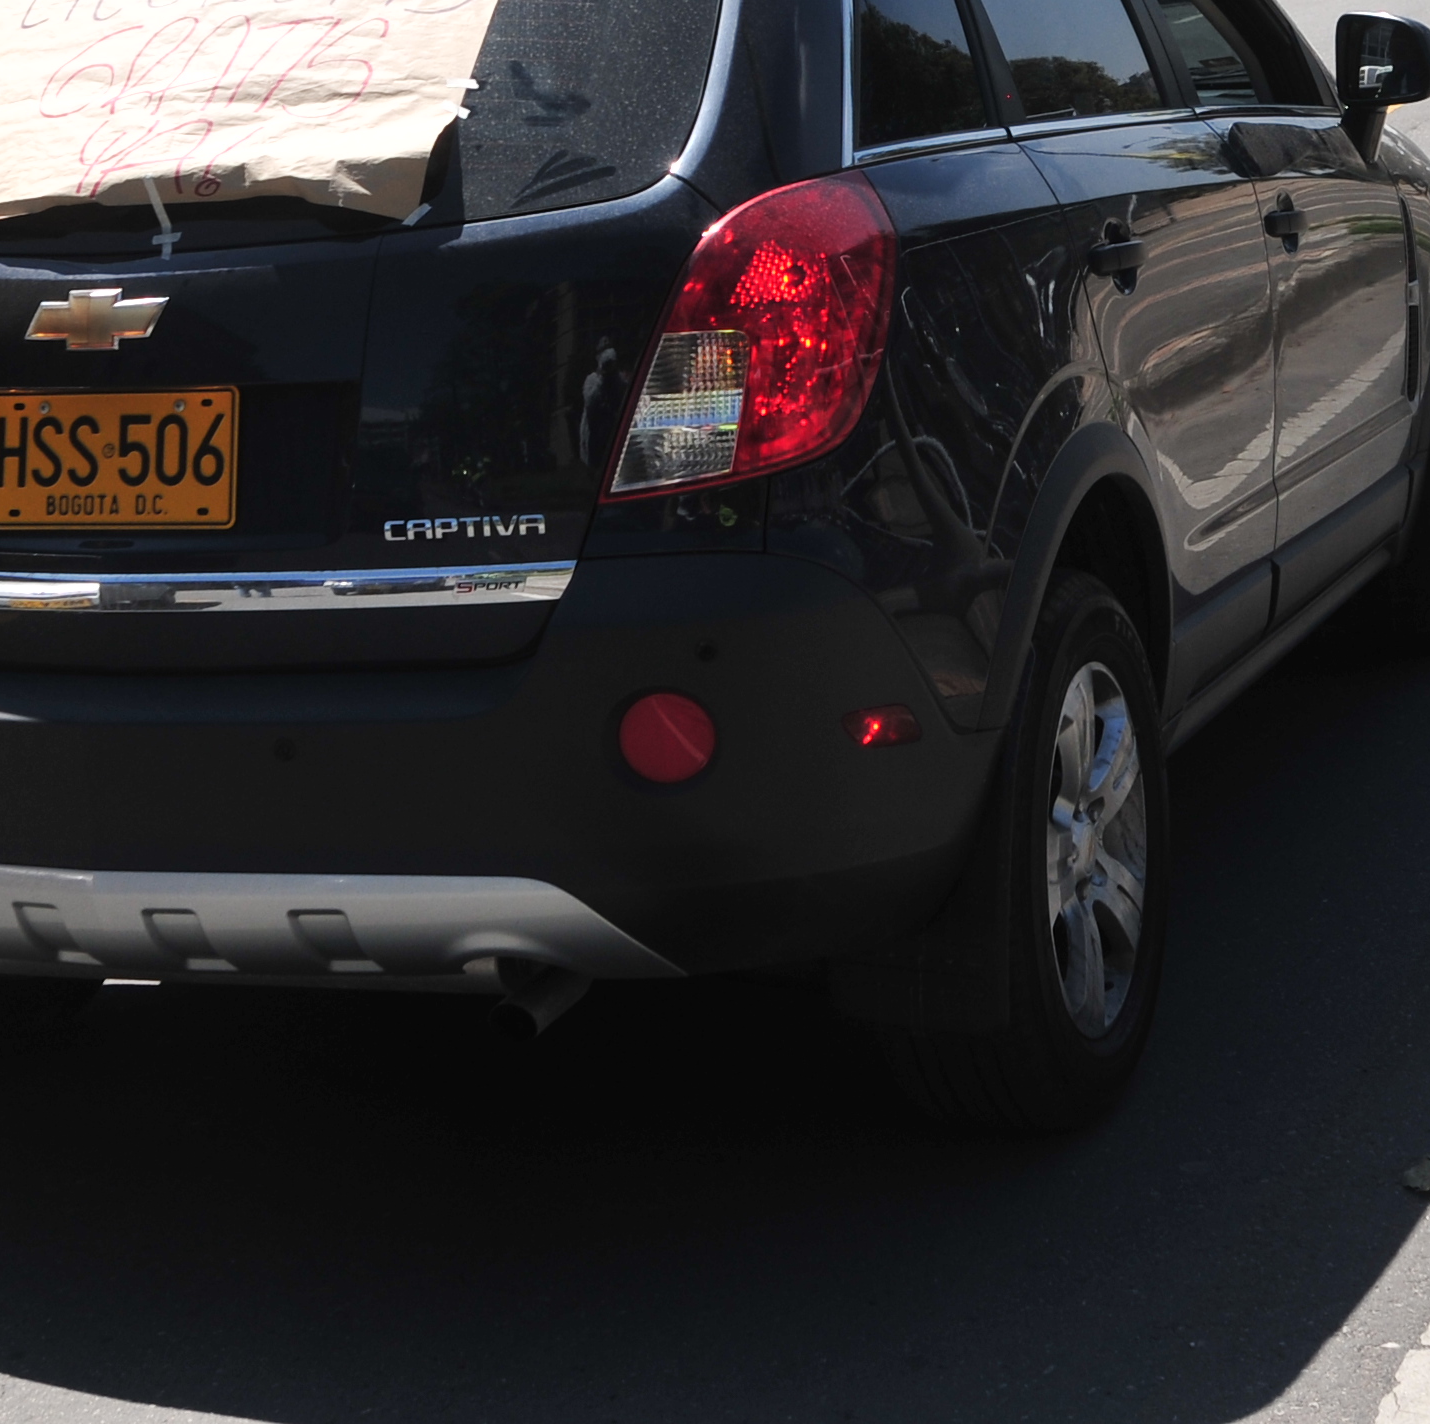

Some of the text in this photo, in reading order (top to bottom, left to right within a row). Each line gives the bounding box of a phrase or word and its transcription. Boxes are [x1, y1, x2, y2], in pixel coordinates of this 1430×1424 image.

[40, 15, 389, 118] GRATIS
[46, 493, 168, 517] BOGOTA D.C.
[383, 514, 546, 541] CAPTIVA
